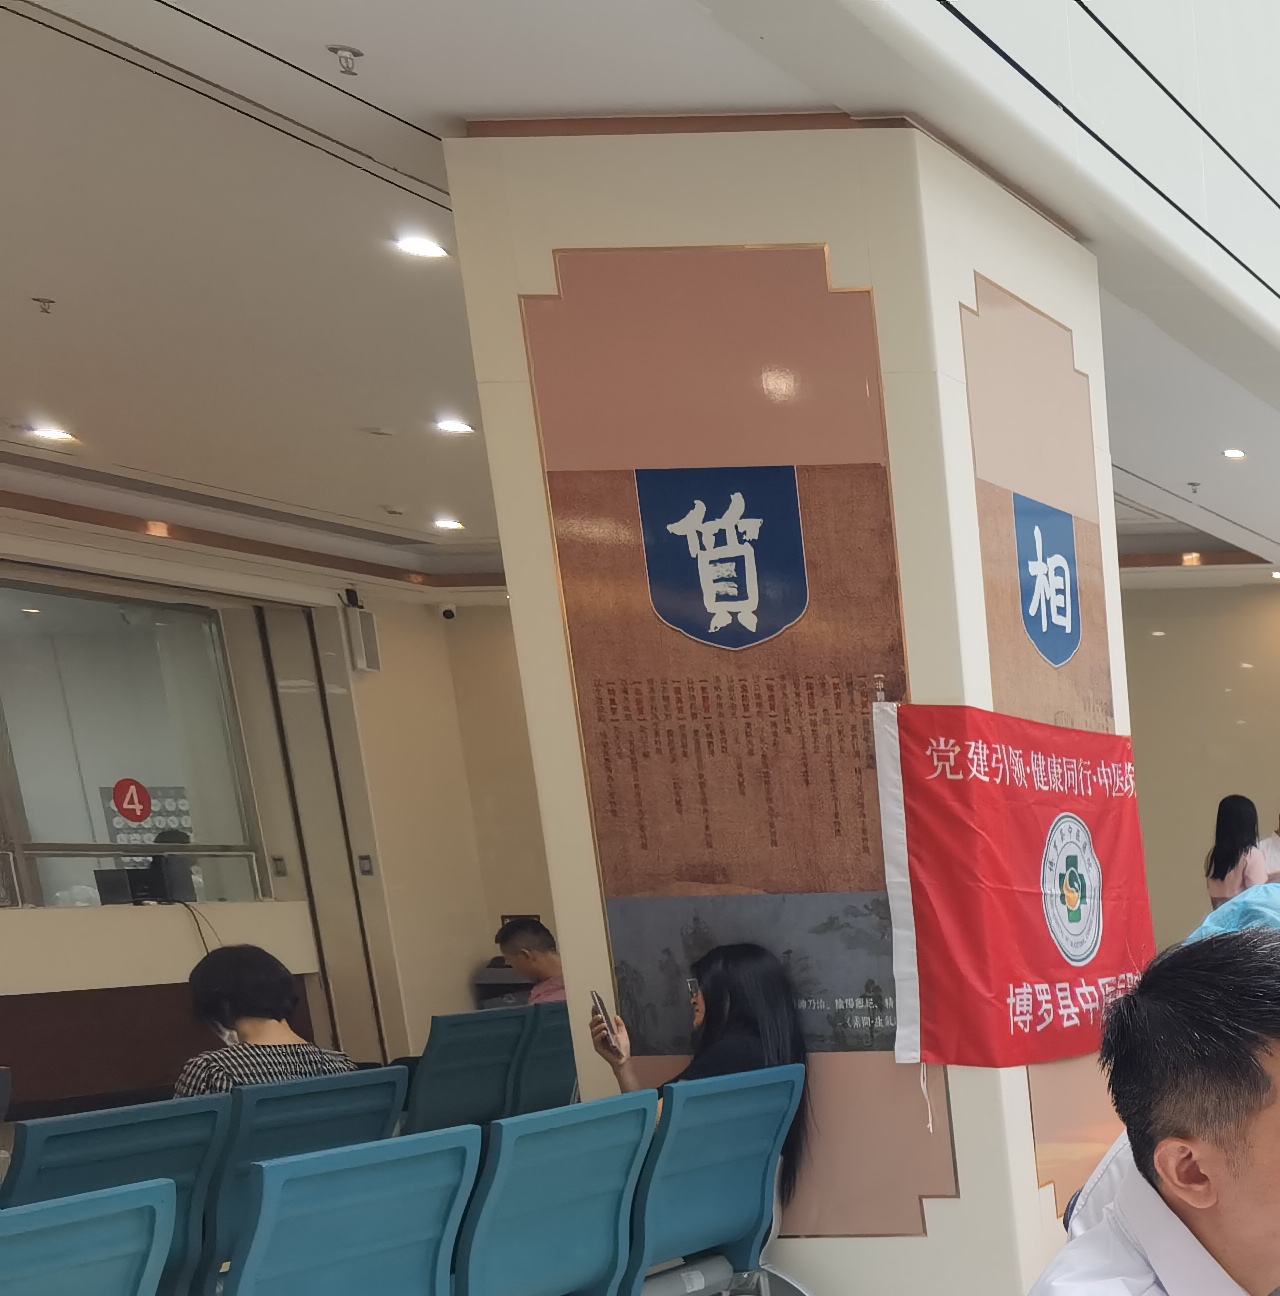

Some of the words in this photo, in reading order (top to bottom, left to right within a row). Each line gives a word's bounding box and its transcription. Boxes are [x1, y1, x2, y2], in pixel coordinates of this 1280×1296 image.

[666, 491, 764, 634] 質
[1027, 524, 1073, 634] 相
[122, 784, 144, 816] 4
